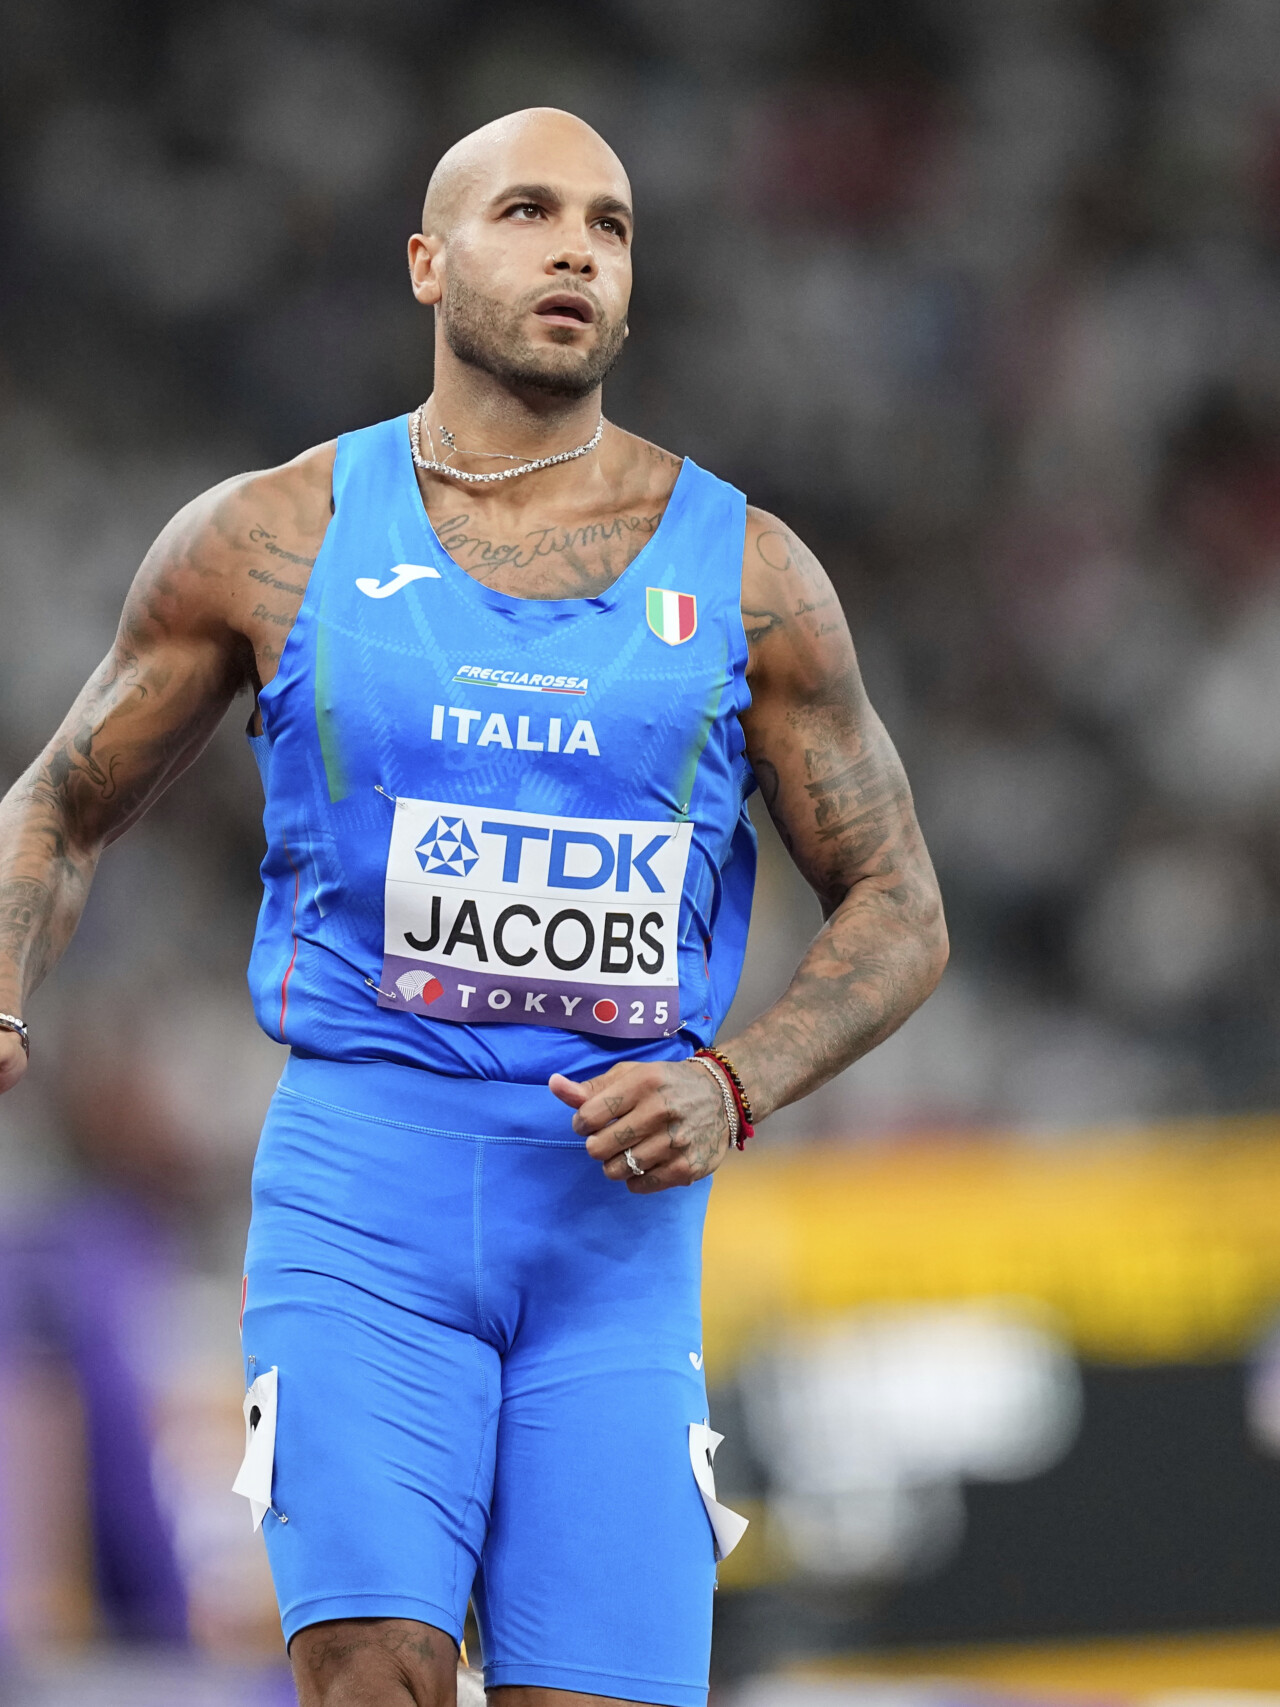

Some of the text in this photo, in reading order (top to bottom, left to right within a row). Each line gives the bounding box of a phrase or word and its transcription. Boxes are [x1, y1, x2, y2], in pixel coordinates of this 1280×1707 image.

[456, 665, 588, 689] FRECCIAROSSA
[430, 704, 601, 757] ITALIA
[481, 820, 676, 894] TDK
[403, 895, 665, 975] JACOBS
